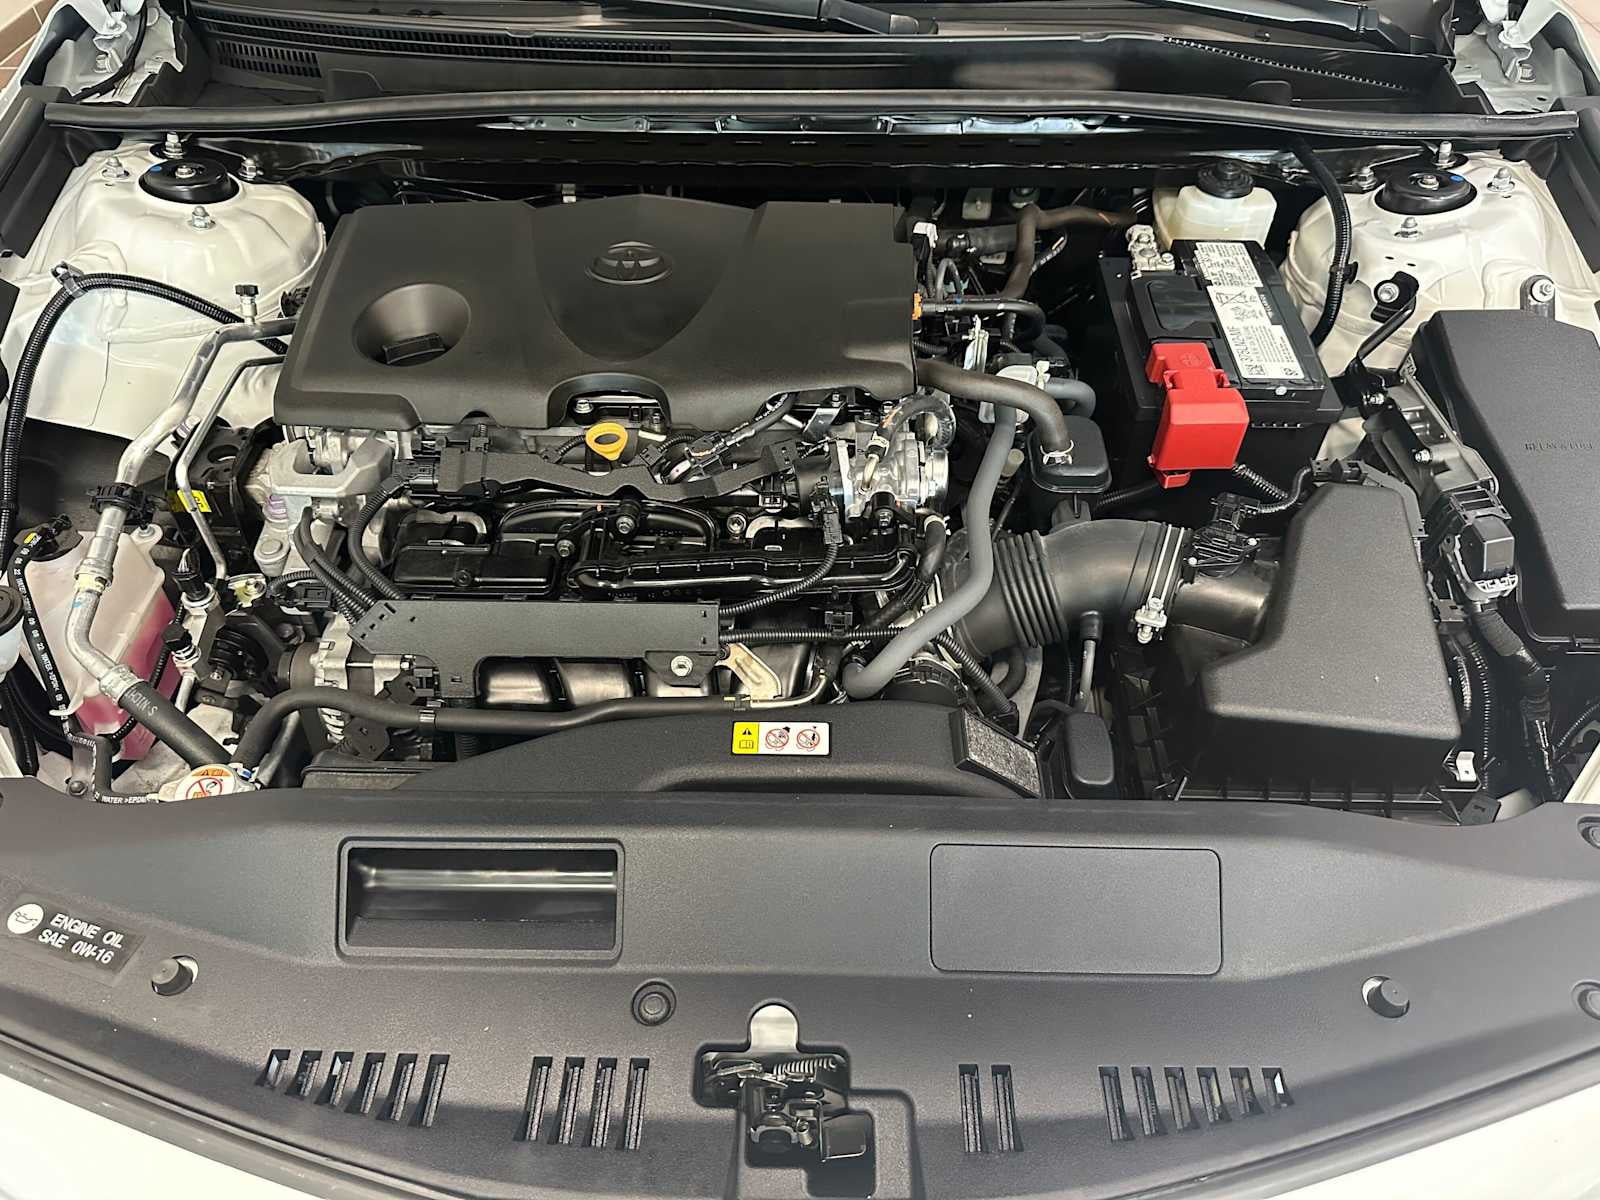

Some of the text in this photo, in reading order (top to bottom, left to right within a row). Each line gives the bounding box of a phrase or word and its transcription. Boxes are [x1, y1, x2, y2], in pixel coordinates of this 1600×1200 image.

[41, 652, 53, 672] WATER
[101, 794, 123, 803] WATER
[50, 913, 124, 948] ENGINE OIL
[38, 929, 114, 964] SAE 0W-16
